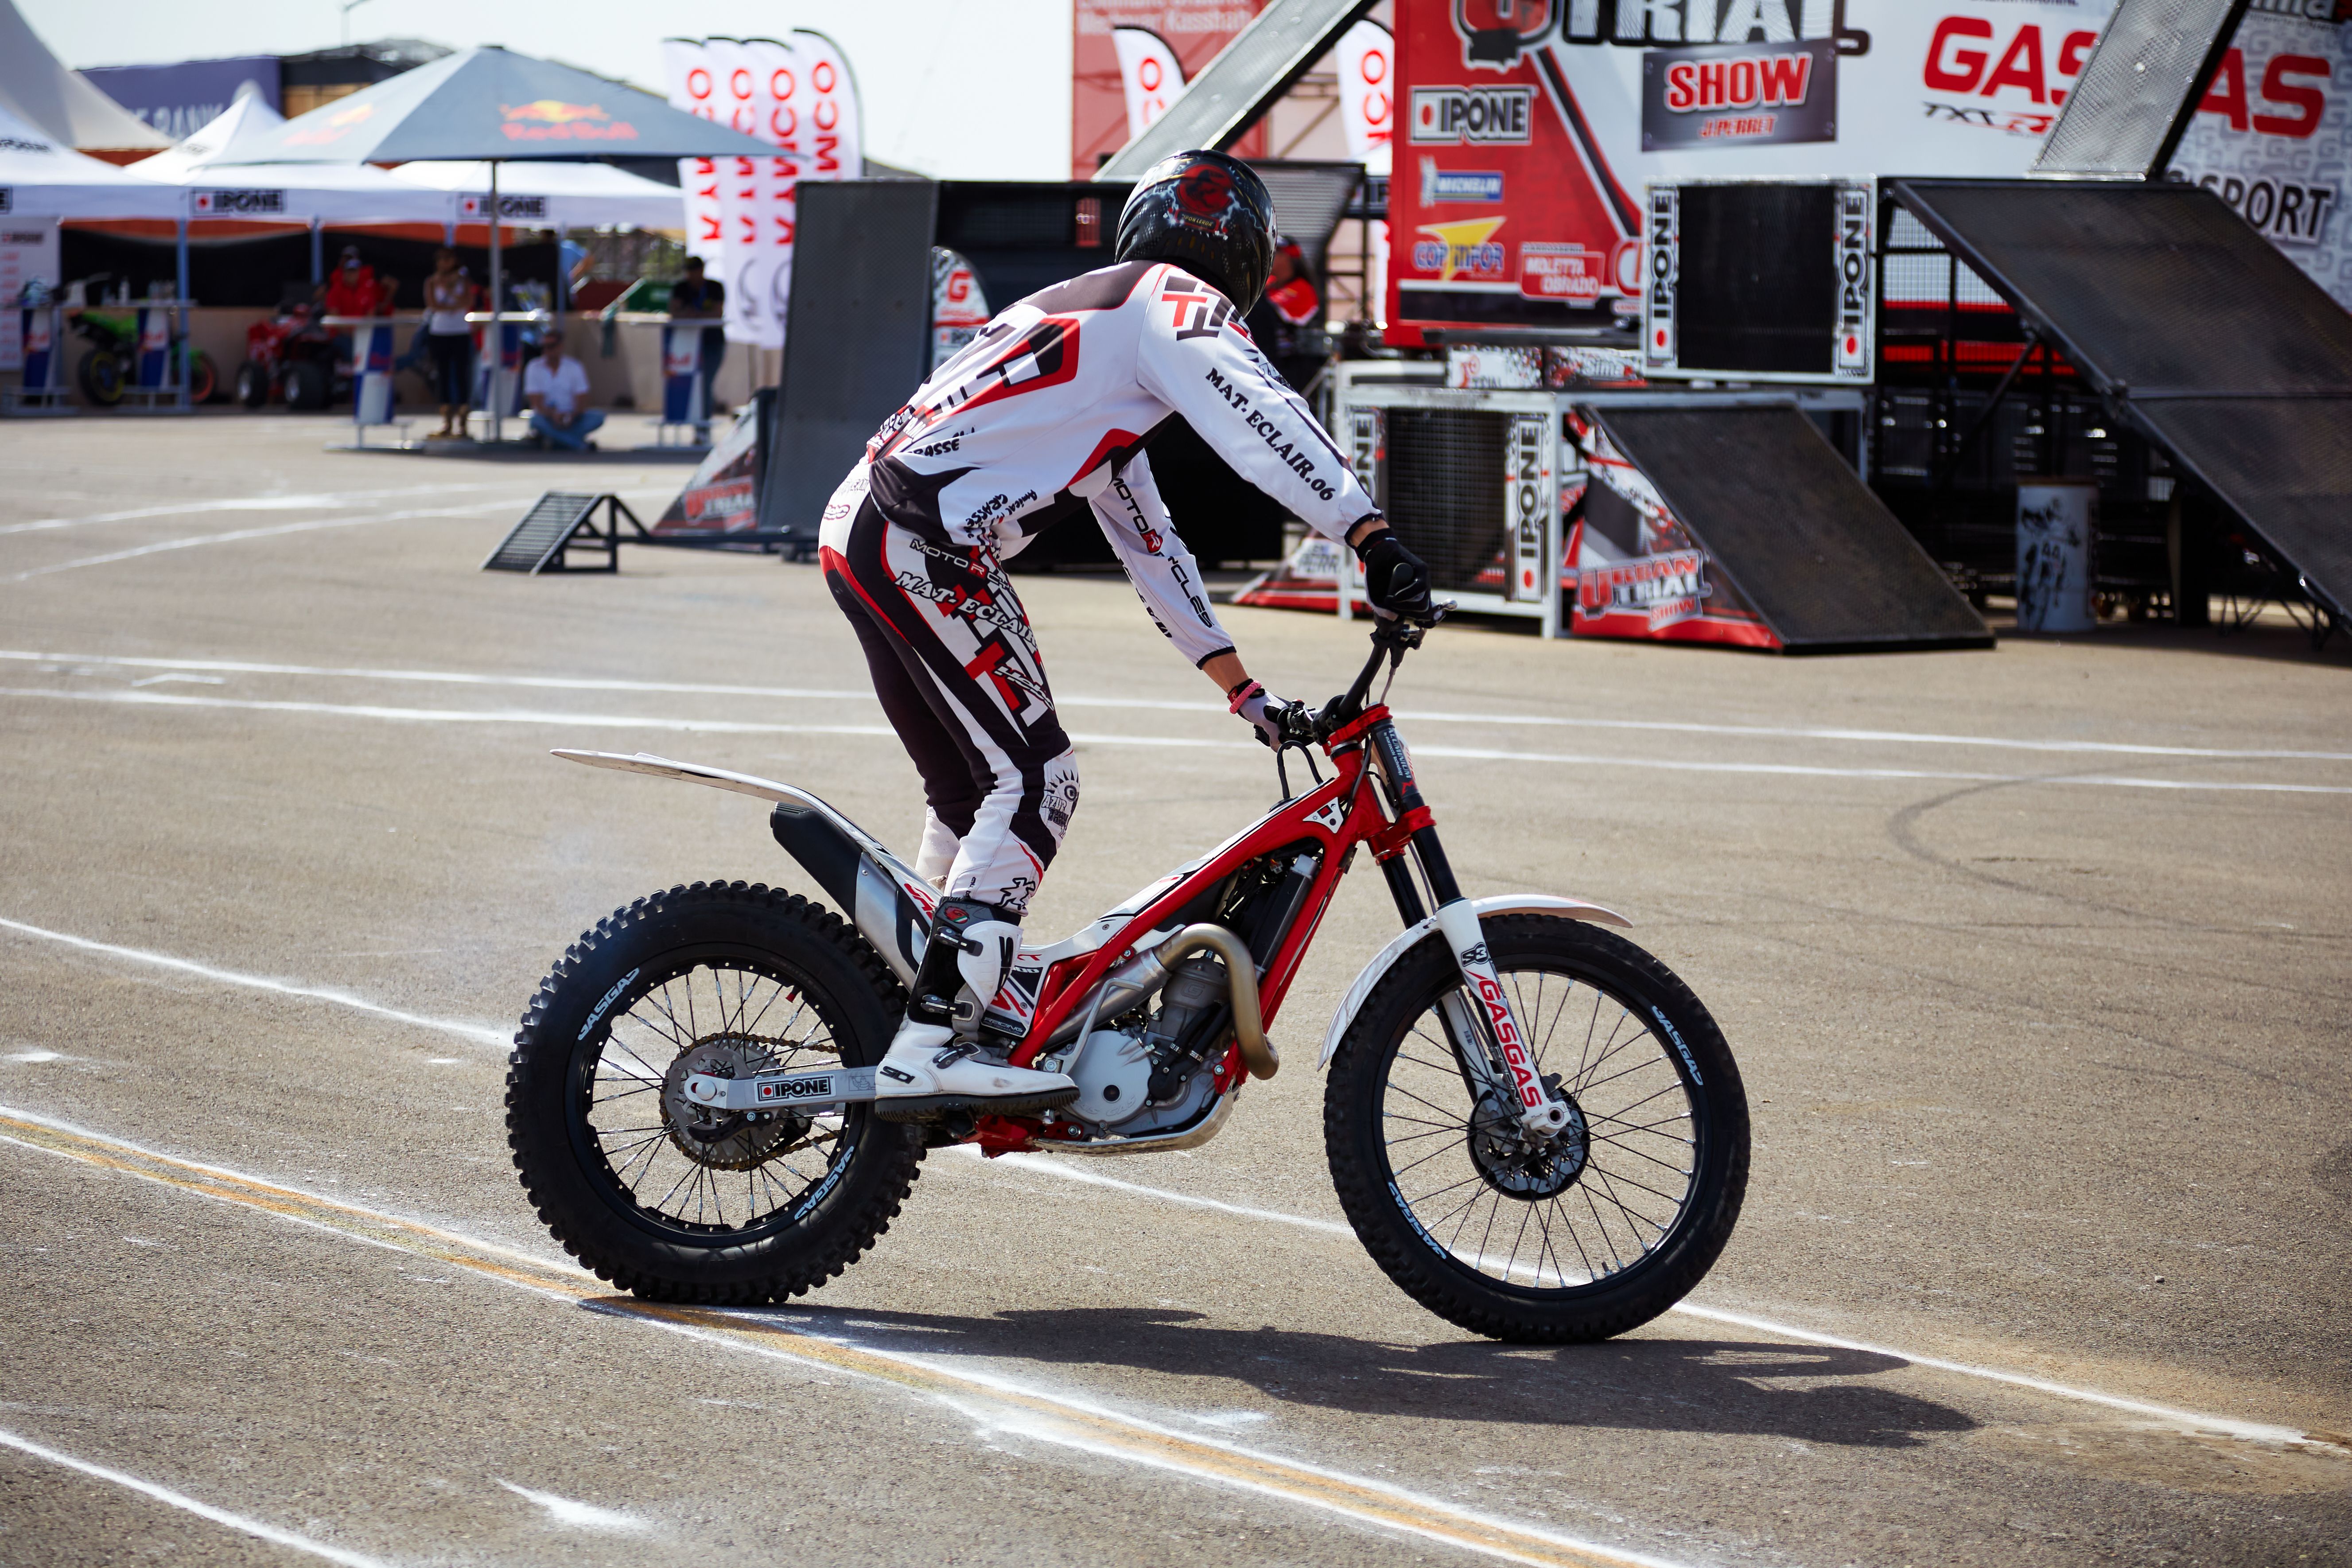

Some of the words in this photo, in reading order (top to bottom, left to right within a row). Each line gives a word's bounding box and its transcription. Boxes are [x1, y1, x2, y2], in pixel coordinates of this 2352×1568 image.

[1668, 54, 1811, 111] SHOW
[1441, 95, 1526, 132] IPONE
[1652, 193, 1672, 319] IPONE
[1842, 195, 1864, 325] IPONE
[1245, 410, 1337, 501] ECLAIR.06
[1520, 425, 1540, 558] IPONE
[1651, 597, 1696, 623] SHOW
[1385, 736, 1396, 756] marzocchi
[1393, 756, 1403, 776] technology
[1388, 727, 1412, 778] ALUMINIUM
[1478, 980, 1543, 1108] GASGAS
[775, 1077, 830, 1098] IPONE
